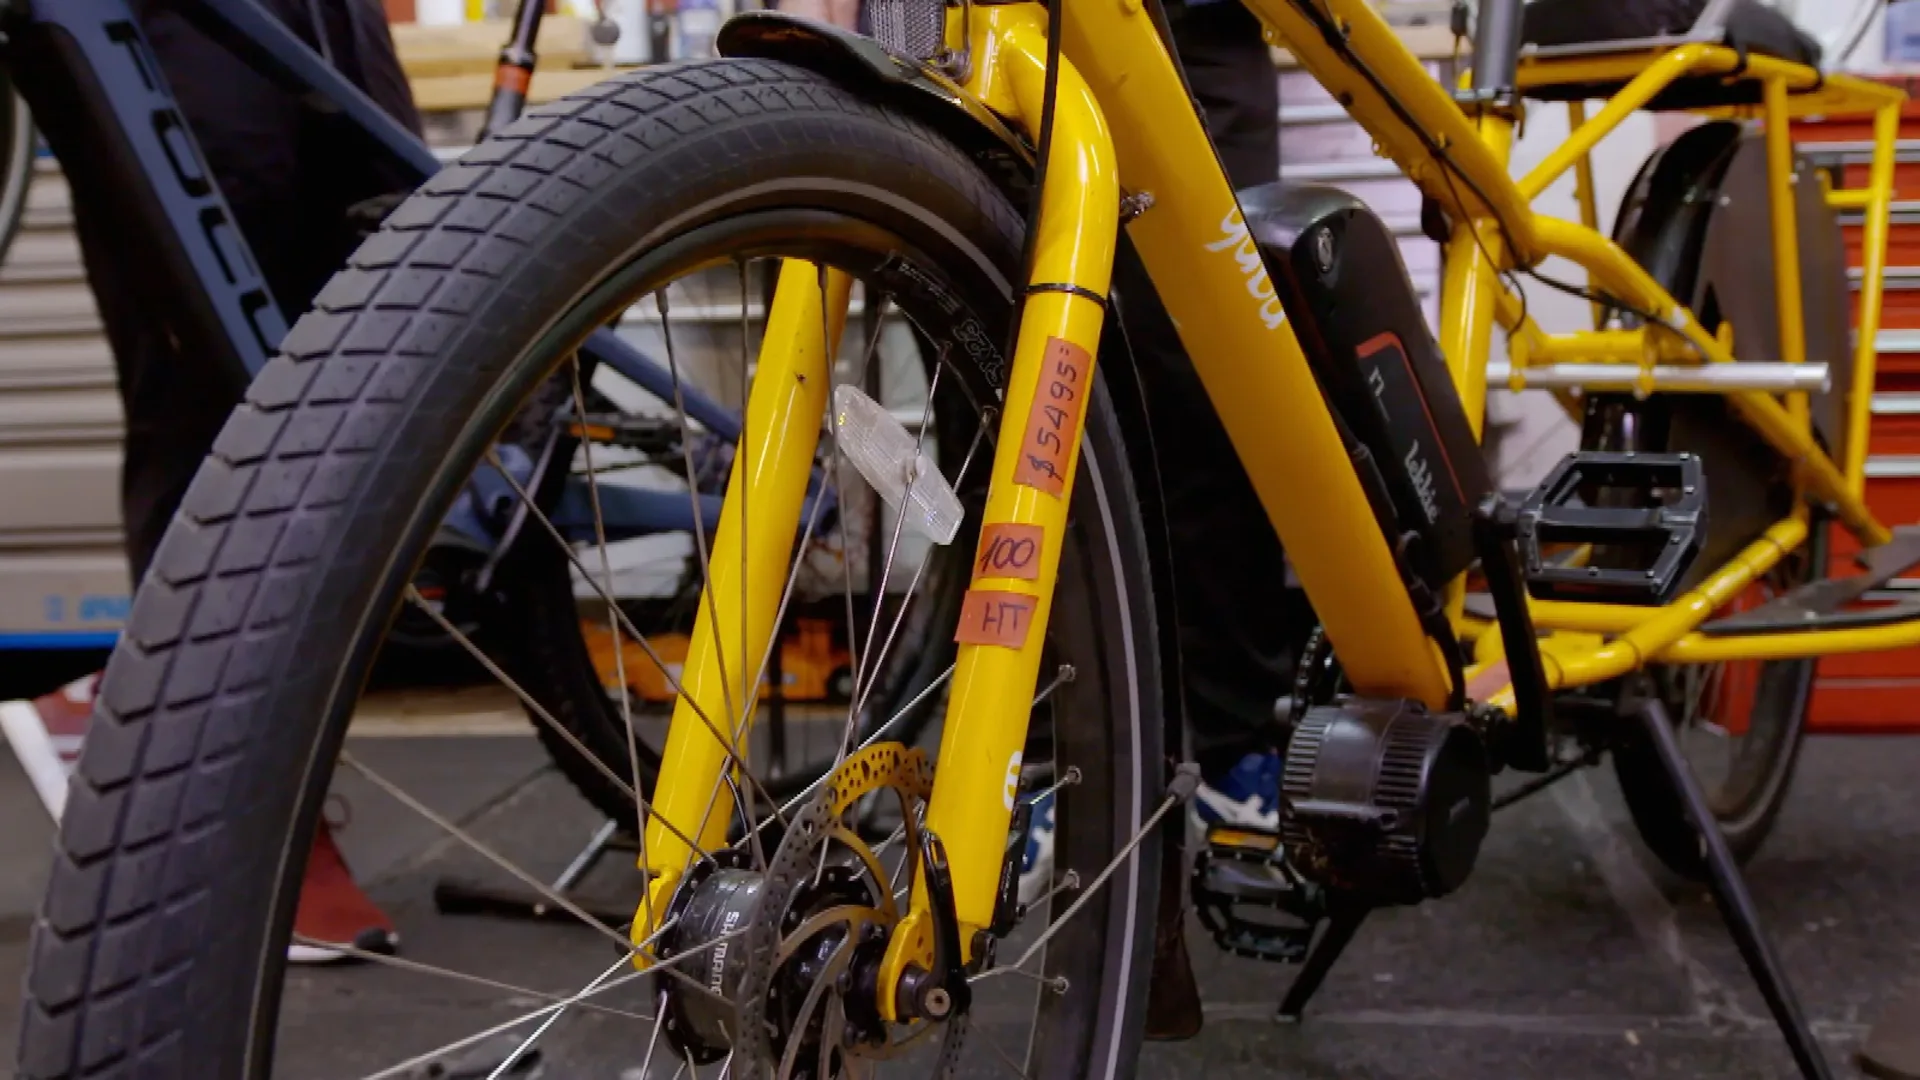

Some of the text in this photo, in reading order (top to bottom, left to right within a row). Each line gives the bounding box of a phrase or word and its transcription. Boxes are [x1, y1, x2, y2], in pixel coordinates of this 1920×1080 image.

[980, 535, 1035, 573] 100
[982, 602, 1028, 636] HT
[710, 911, 740, 997] SHMANO
